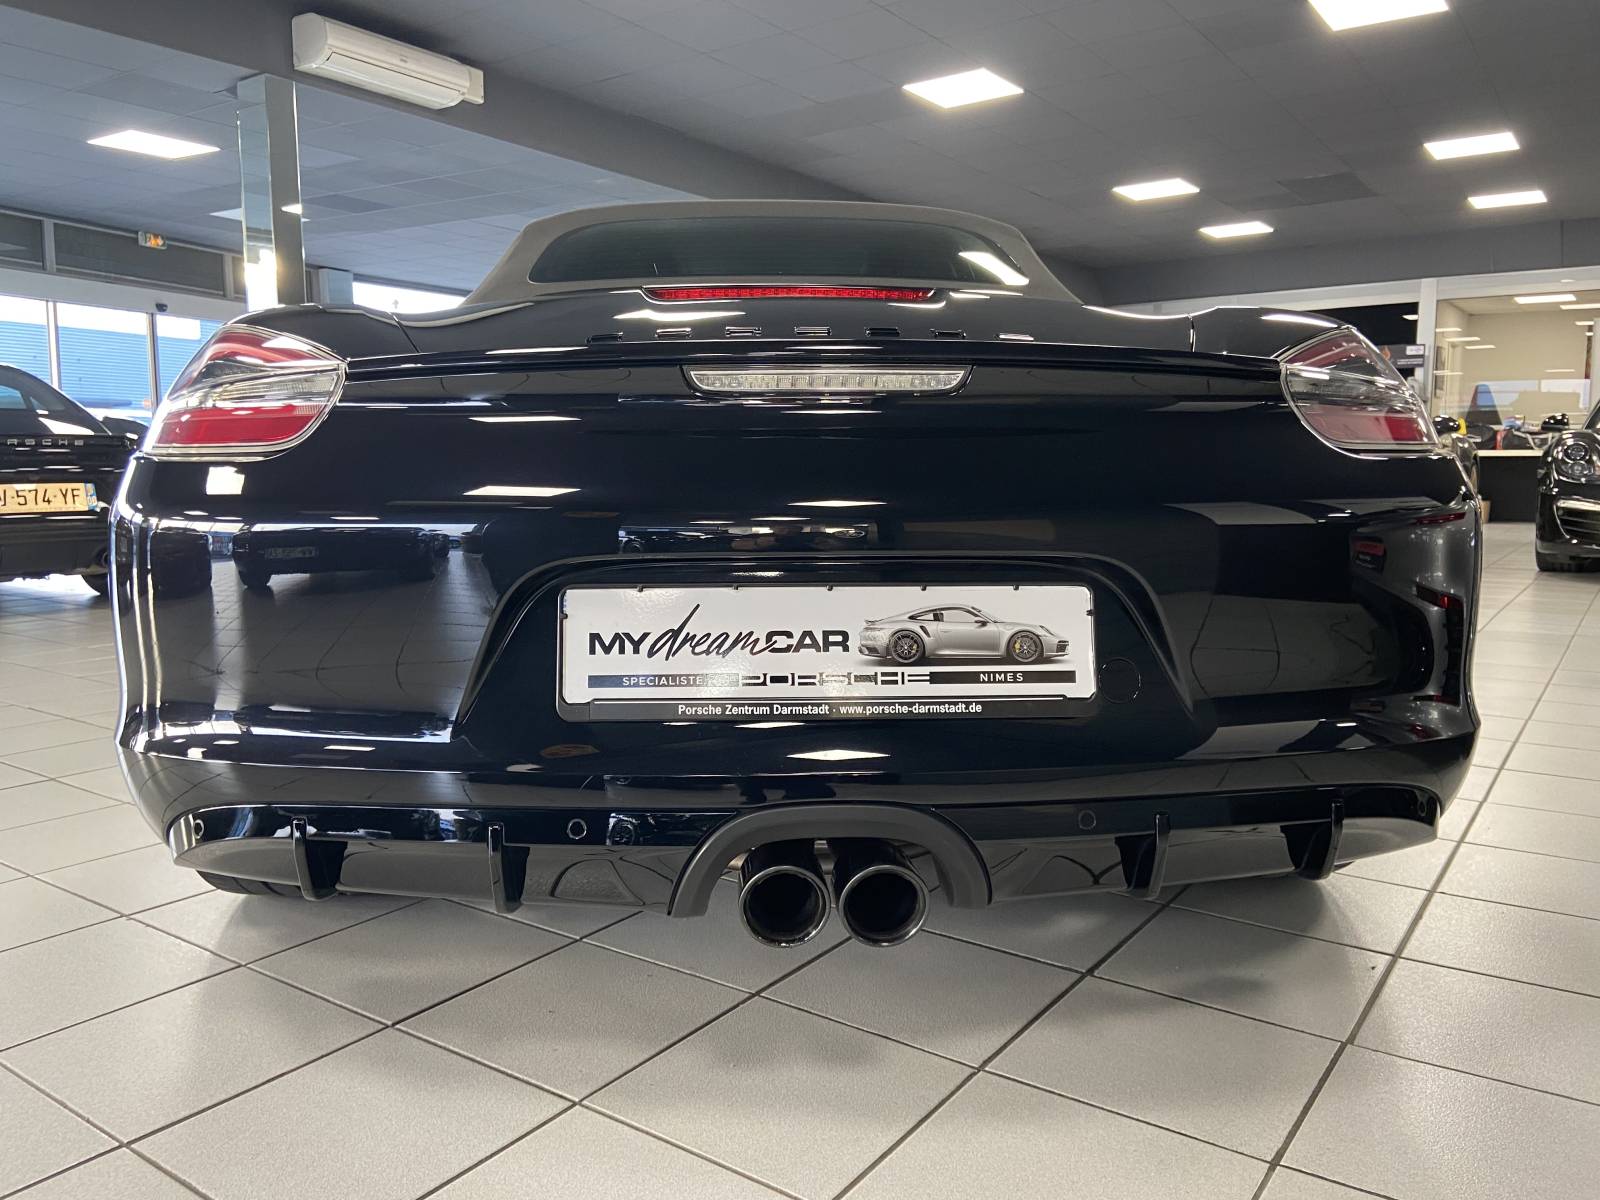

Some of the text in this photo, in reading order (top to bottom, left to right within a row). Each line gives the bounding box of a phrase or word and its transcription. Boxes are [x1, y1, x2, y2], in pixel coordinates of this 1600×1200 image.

[622, 676, 703, 686] SPECIALISTE
[979, 672, 1025, 682] NIMES
[678, 703, 983, 715] Porsche Zentrum Darmstadt www.porsche-darmstadt.de
